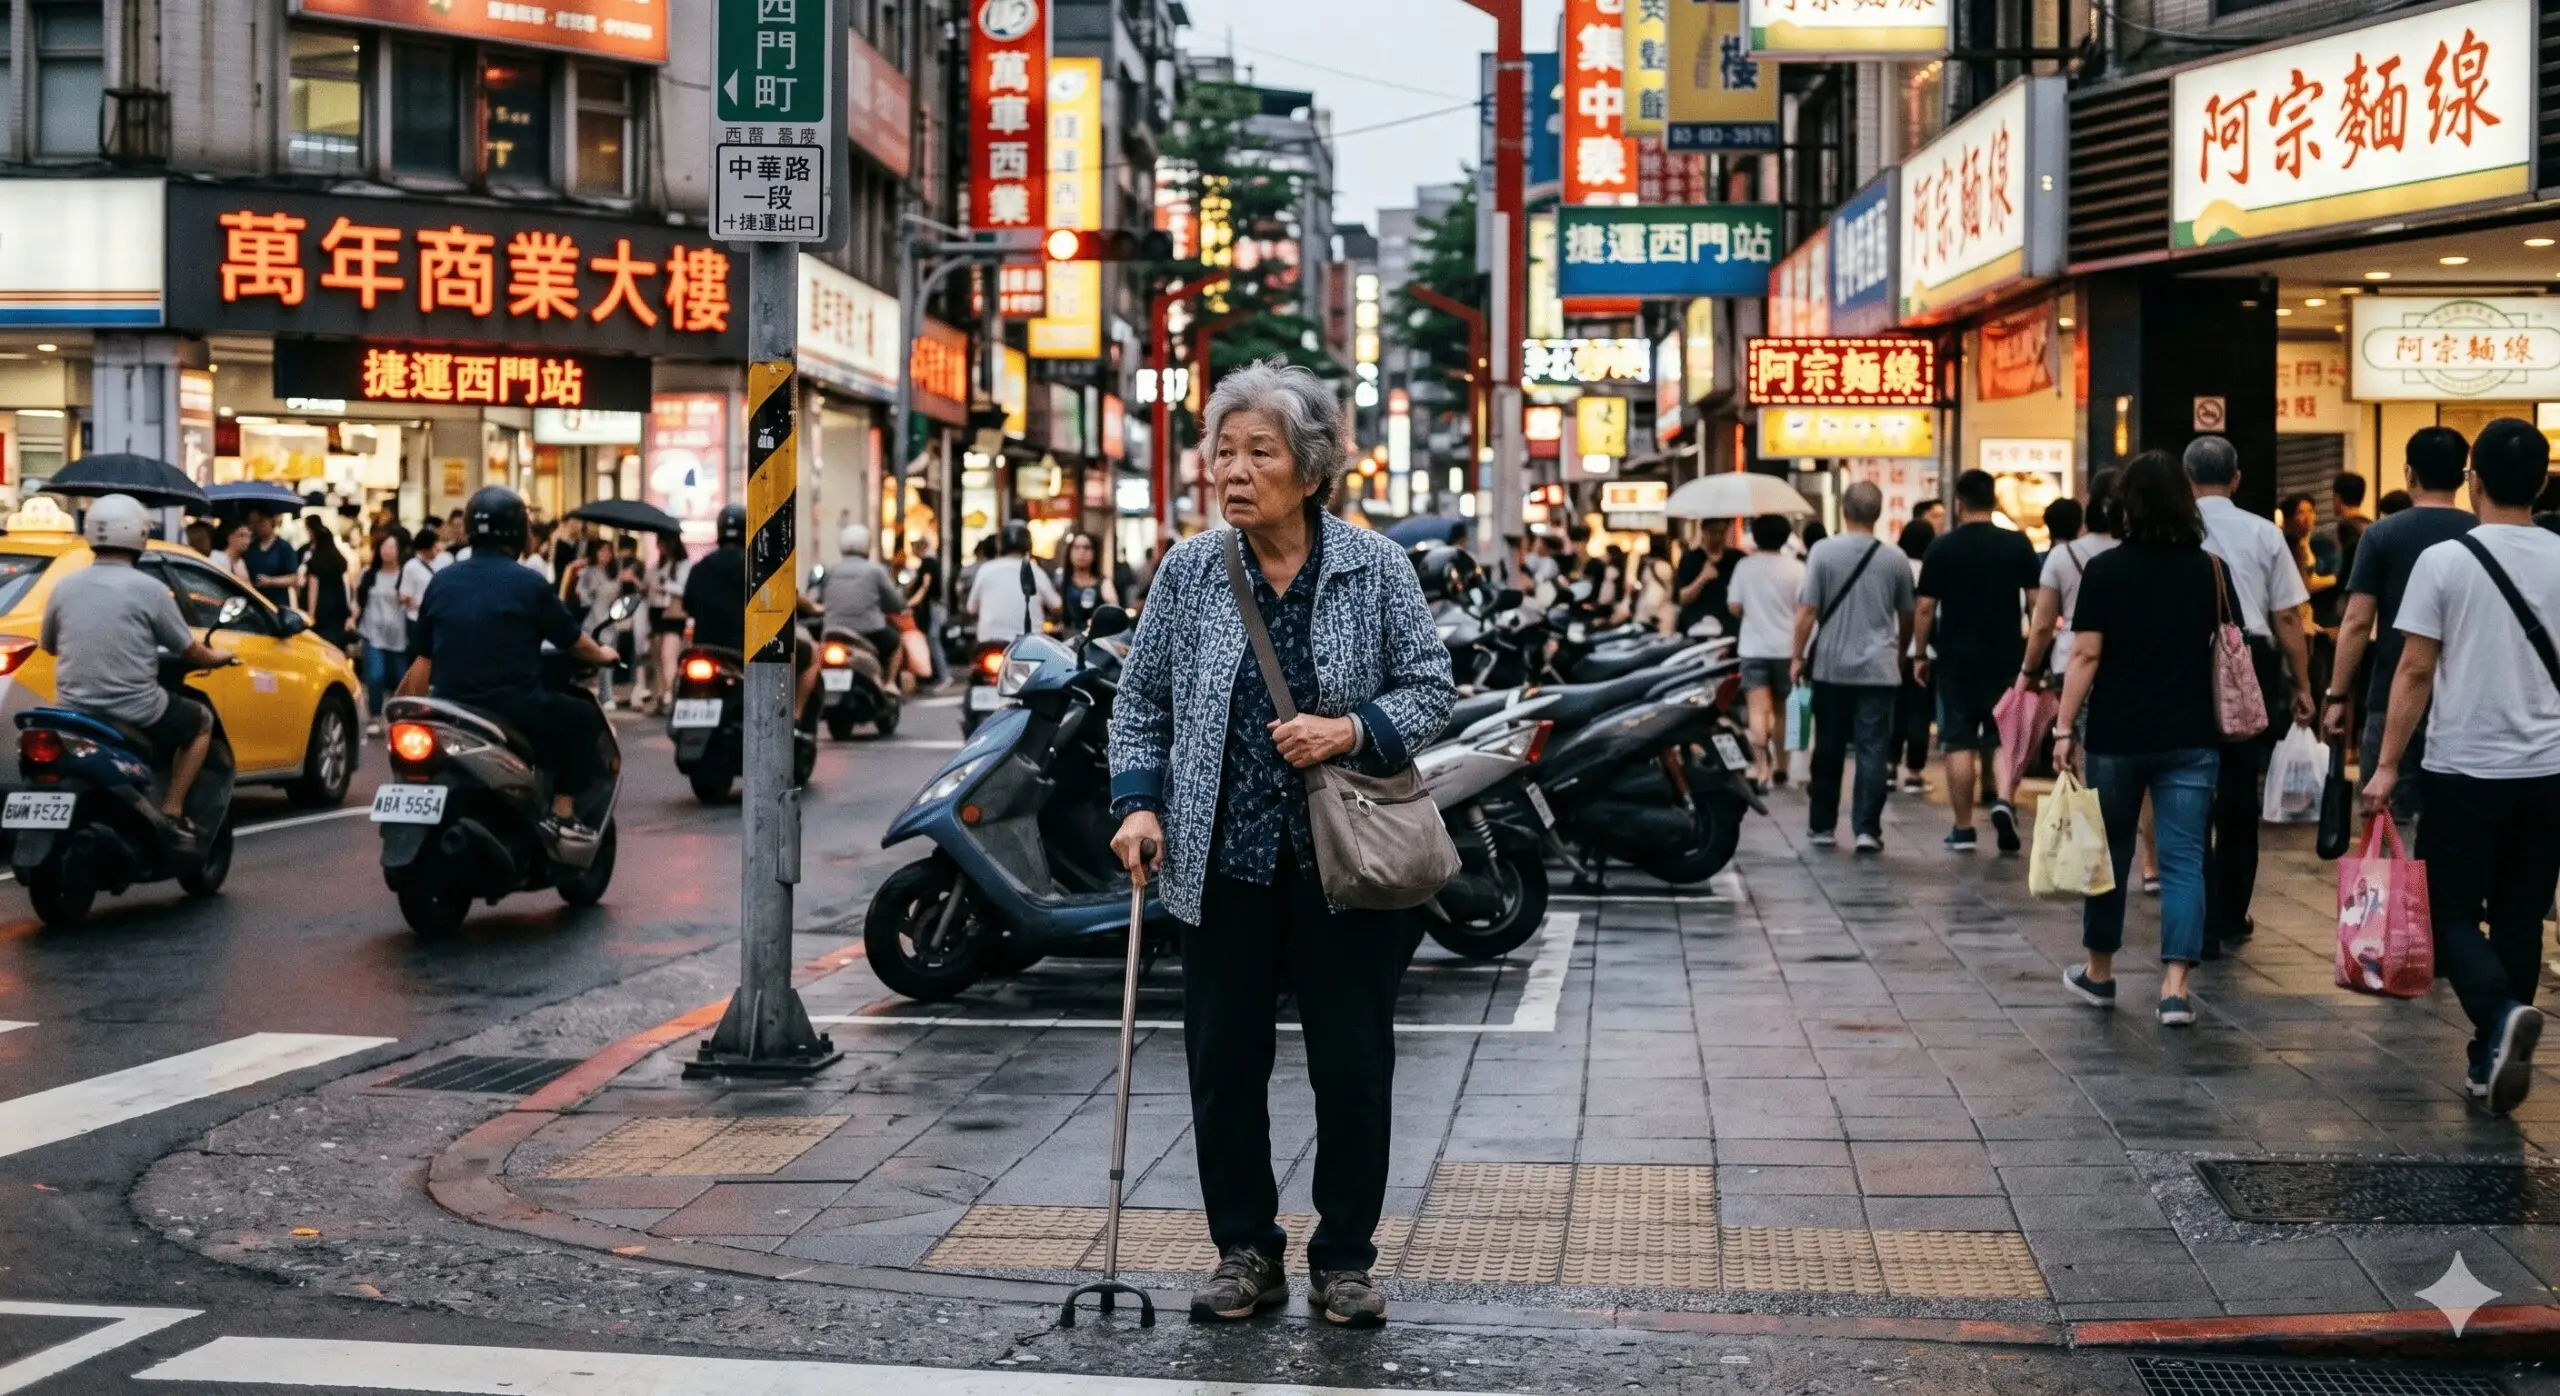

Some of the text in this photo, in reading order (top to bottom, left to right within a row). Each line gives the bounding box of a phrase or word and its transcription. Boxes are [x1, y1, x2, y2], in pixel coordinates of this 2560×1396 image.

[755, 0, 798, 112] 西門町
[2199, 26, 2501, 187] 阿宗麵線
[729, 154, 811, 182] 中華路
[1911, 117, 2014, 269] 阿宗麵線
[743, 185, 793, 210] 一段
[1564, 220, 1773, 265] 捷運西門站
[218, 209, 732, 333] 萬年商業大樓
[1758, 347, 1925, 397] 阿宗麵線
[2395, 332, 2536, 365] 阿宗麵線
[363, 348, 584, 406] 捷運西門站
